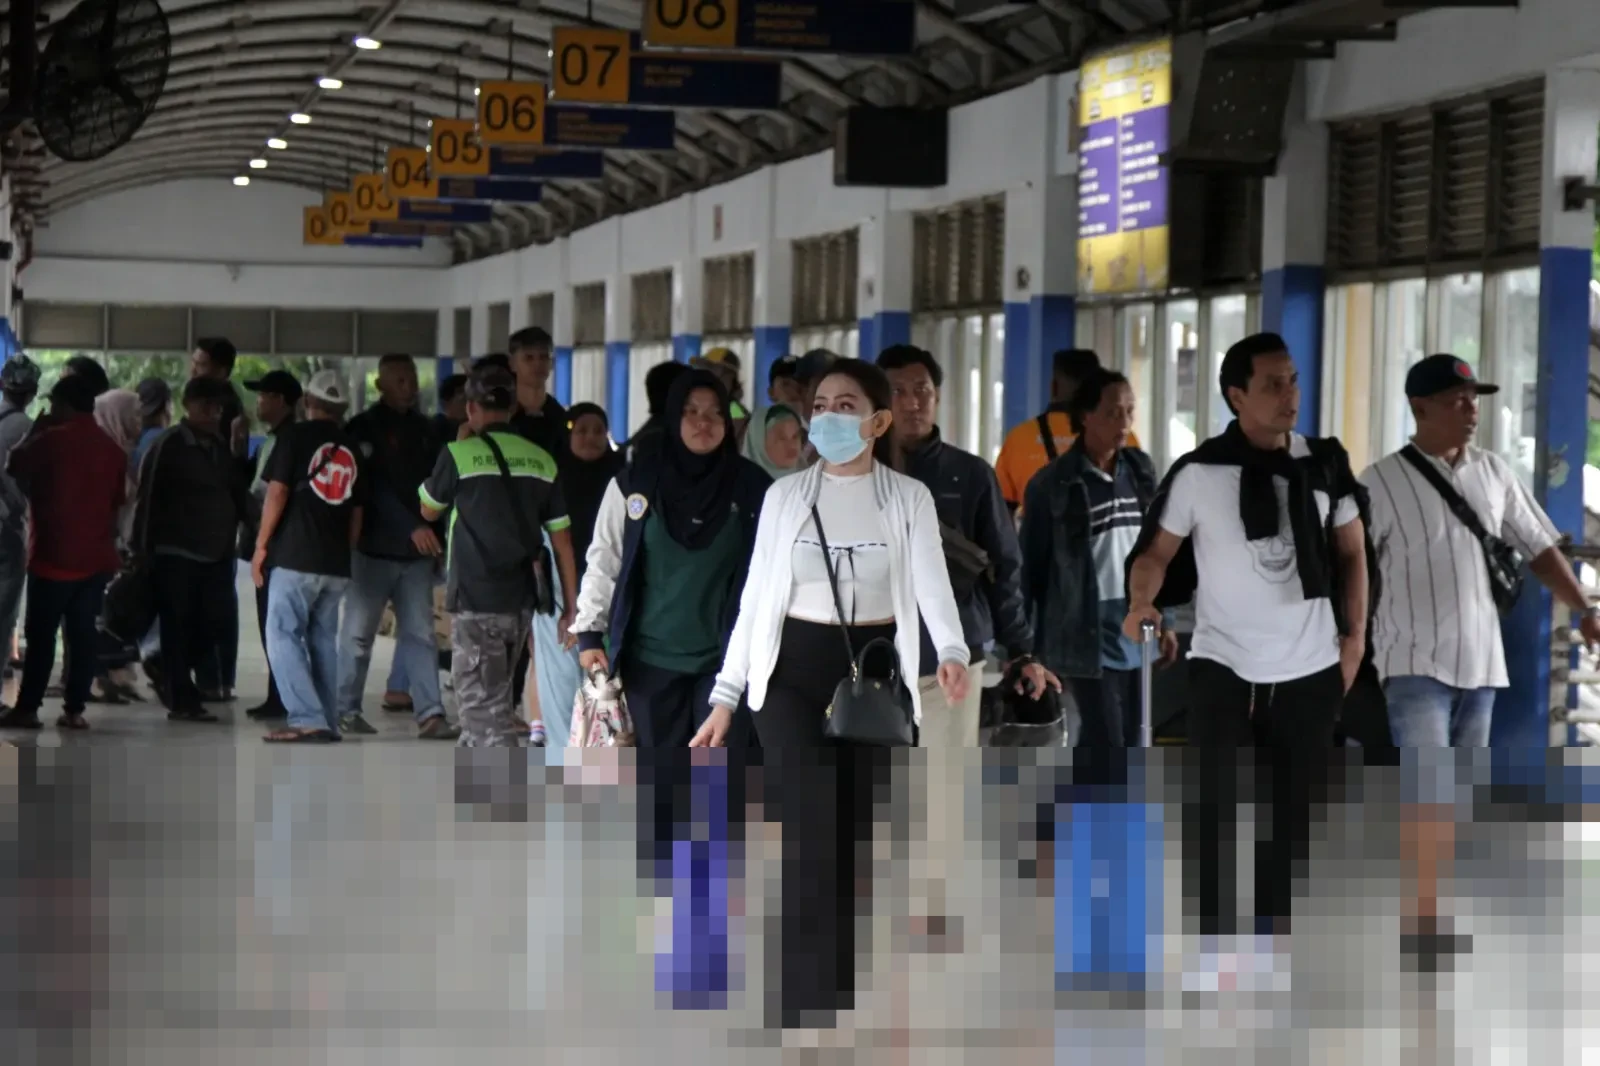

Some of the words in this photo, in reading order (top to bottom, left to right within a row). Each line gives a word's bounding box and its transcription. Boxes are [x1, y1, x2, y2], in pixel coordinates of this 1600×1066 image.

[657, 0, 725, 29] 08
[560, 43, 620, 88] 07
[486, 93, 536, 132] 06
[437, 130, 482, 164] 05
[392, 157, 430, 188] 04
[330, 200, 365, 226] 0
